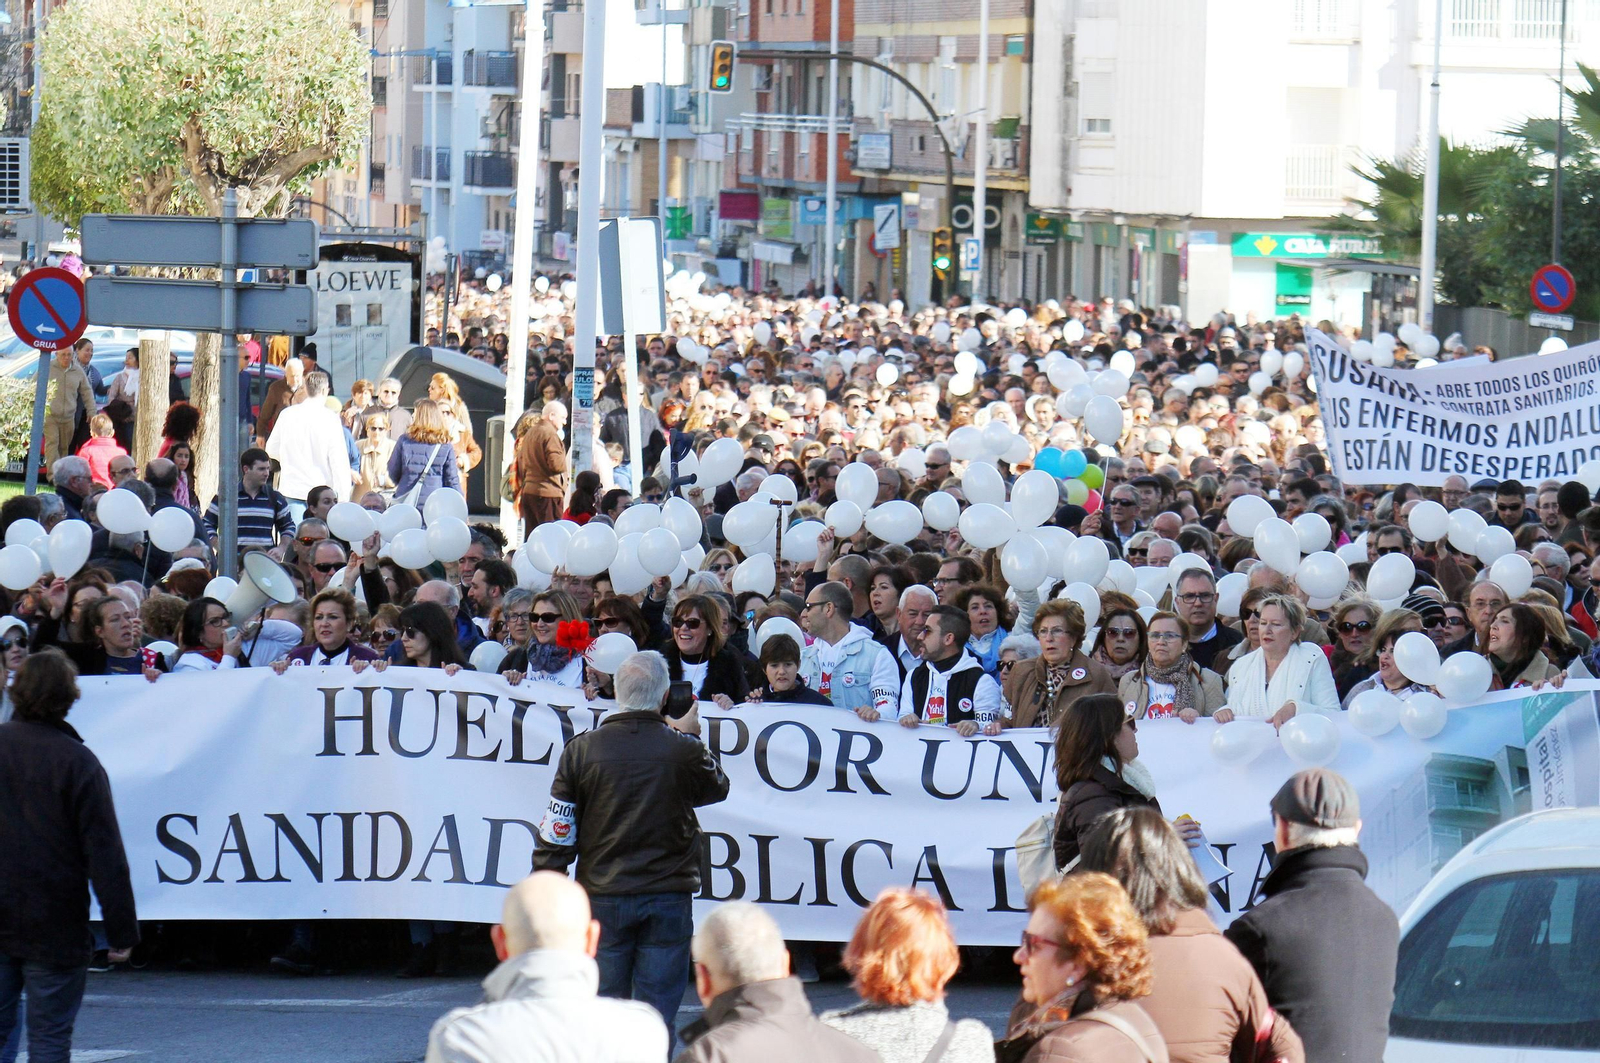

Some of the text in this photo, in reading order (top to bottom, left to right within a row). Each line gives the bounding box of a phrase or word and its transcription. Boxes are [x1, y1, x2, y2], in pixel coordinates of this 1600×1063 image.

[967, 242, 976, 267] P
[316, 269, 402, 292] LOEWE
[33, 340, 57, 349] GRUA
[1436, 383, 1472, 398] ABRE
[1474, 376, 1520, 397] TODOS
[1523, 370, 1550, 389] LOS
[1440, 399, 1511, 417] CONTRATA
[1514, 380, 1598, 411] SANITARIOS.
[1358, 398, 1498, 448] ENFERMOS
[1343, 432, 1412, 471] ESTÁN
[315, 686, 1058, 804] HUELV POR UN
[1535, 736, 1555, 808] ospital
[155, 811, 538, 888] SANIDAD
[692, 832, 964, 912] BLICA
